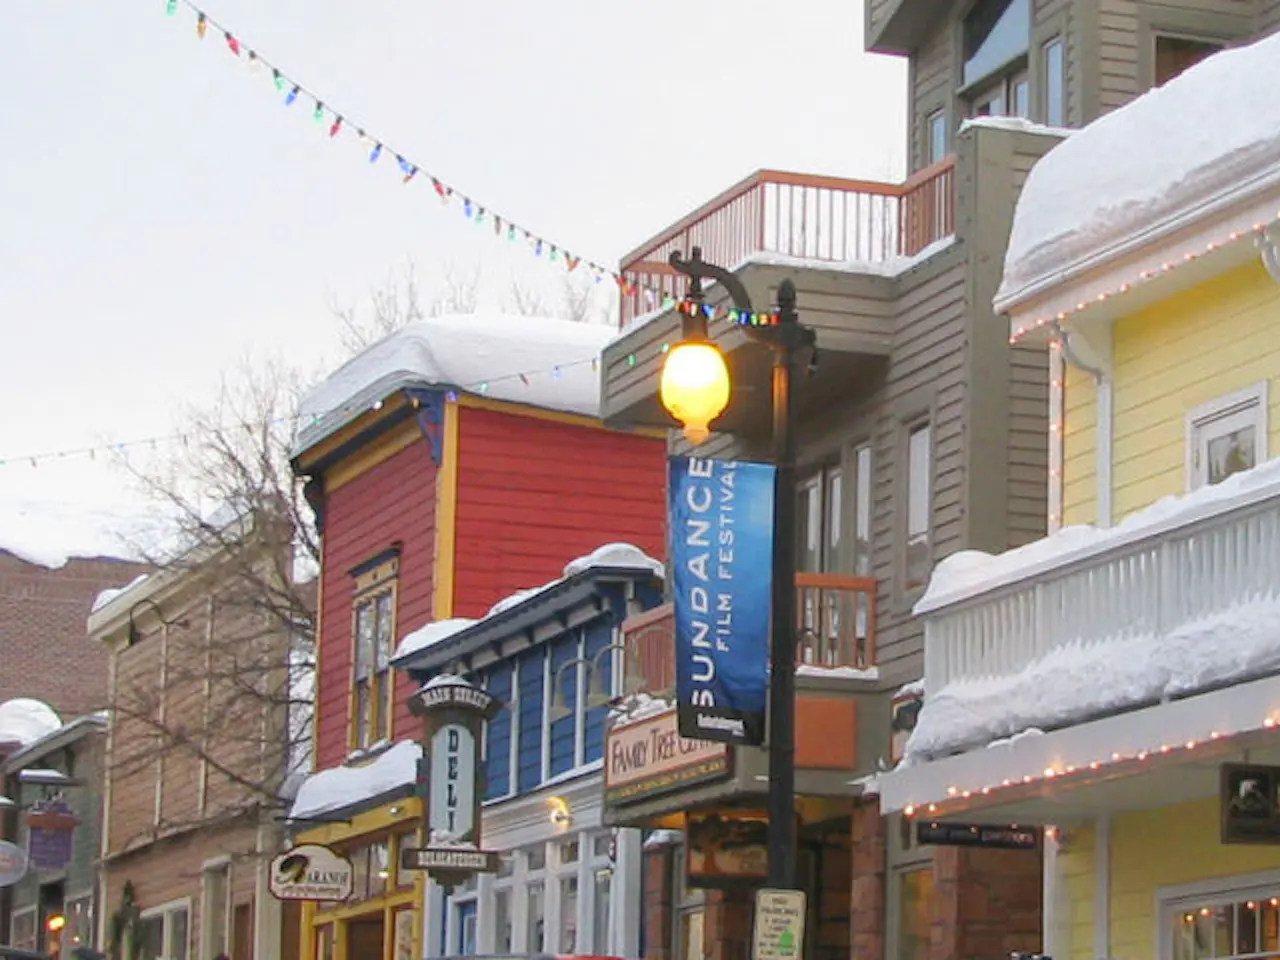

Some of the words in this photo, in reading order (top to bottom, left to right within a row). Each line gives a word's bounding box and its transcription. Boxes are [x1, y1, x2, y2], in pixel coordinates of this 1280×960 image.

[718, 460, 737, 580] FESTIVAL
[686, 456, 717, 708] SUNDANCE
[716, 594, 733, 652] FILM
[447, 729, 459, 832] DELI
[611, 738, 649, 774] FAMILY
[650, 728, 677, 764] TREE
